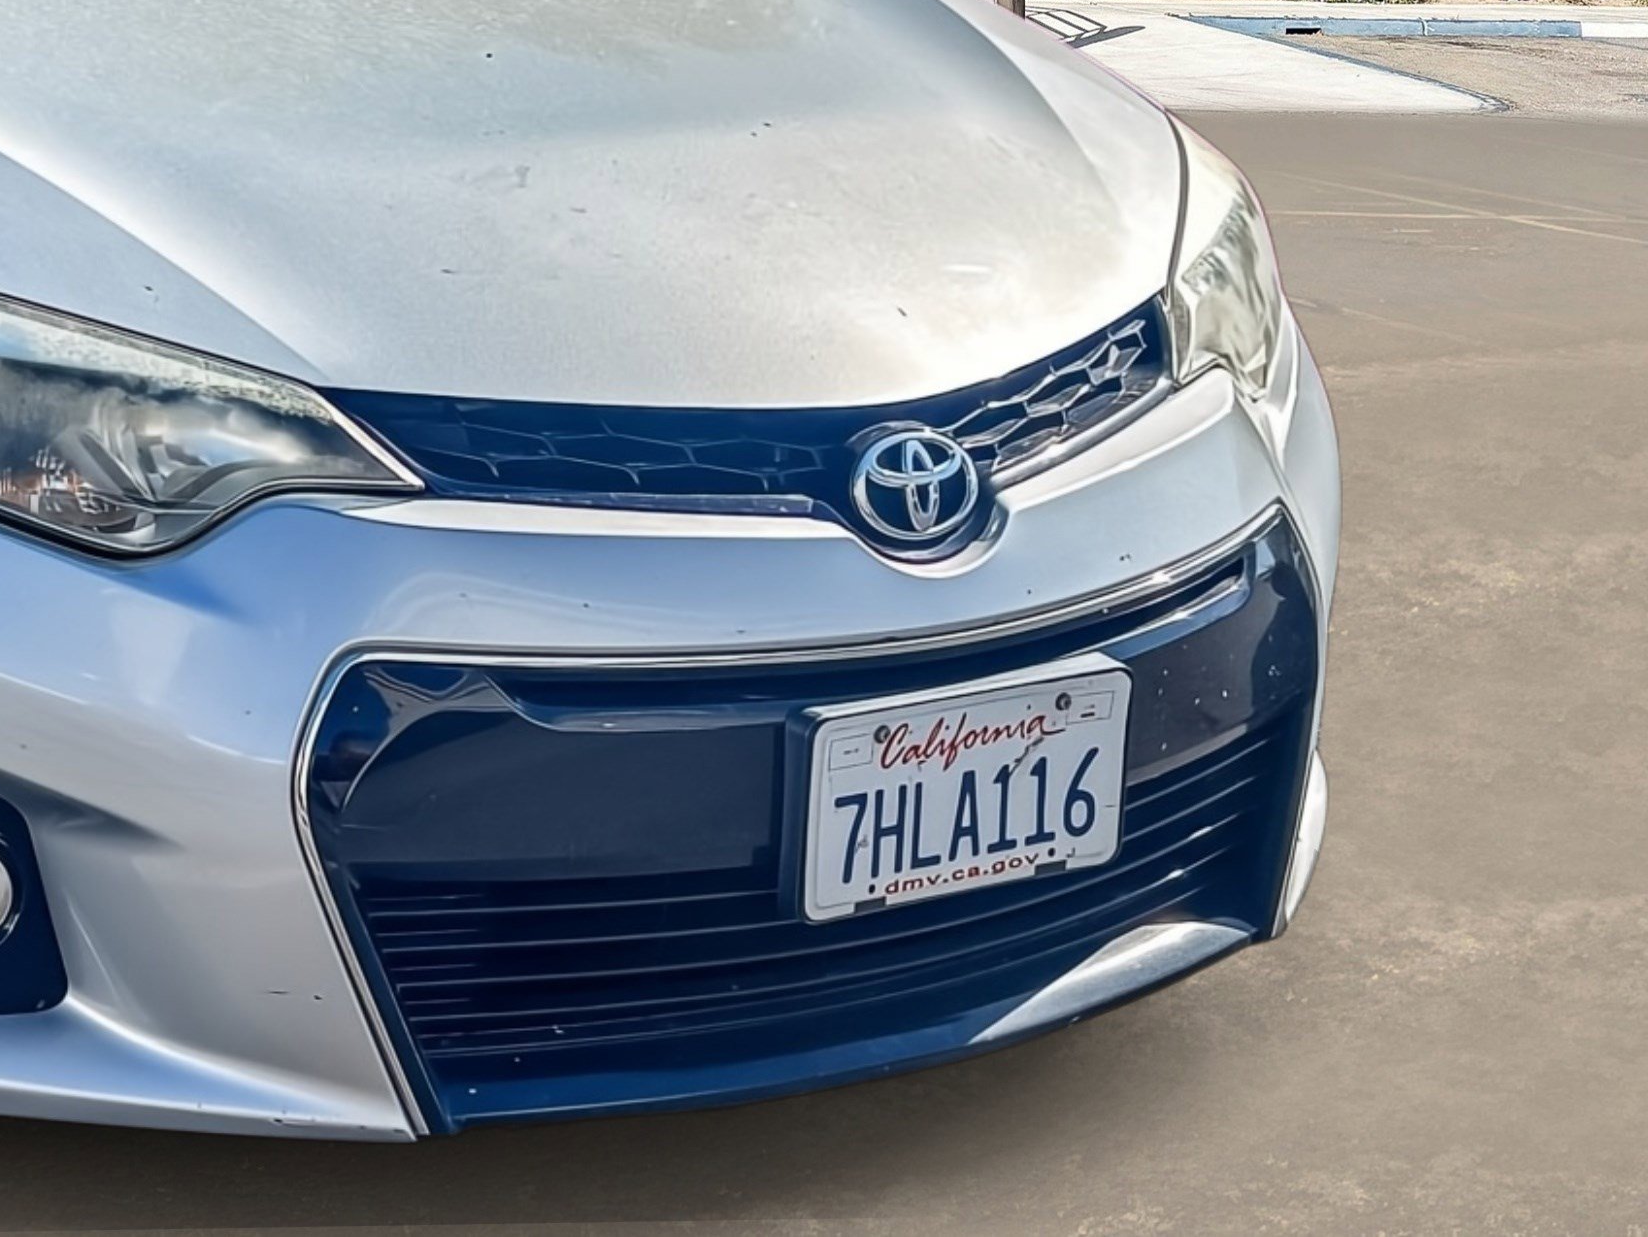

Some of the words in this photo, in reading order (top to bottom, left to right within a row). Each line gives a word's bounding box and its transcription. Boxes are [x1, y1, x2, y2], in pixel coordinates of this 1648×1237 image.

[879, 712, 1066, 772] California
[834, 746, 1100, 885] 7HLA116
[884, 851, 1040, 896] dmv.ca.gov
